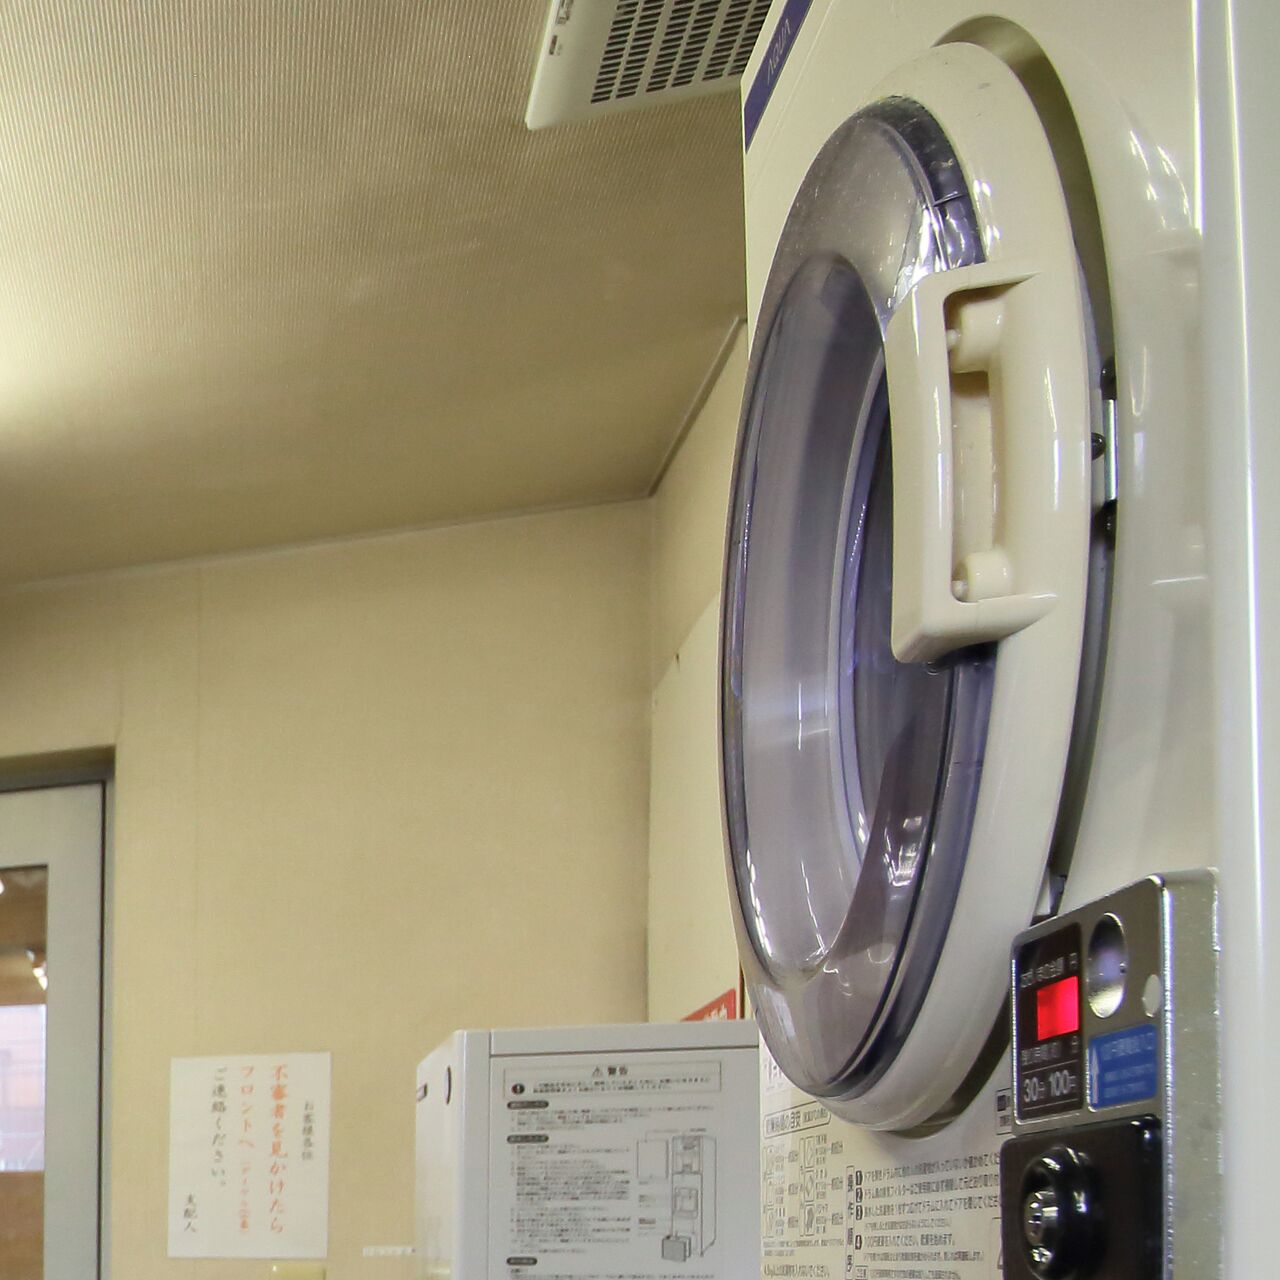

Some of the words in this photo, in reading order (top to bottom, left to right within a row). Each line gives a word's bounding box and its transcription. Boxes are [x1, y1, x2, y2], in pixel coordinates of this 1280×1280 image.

[268, 1063, 289, 1234] 不審者を見かけたら
